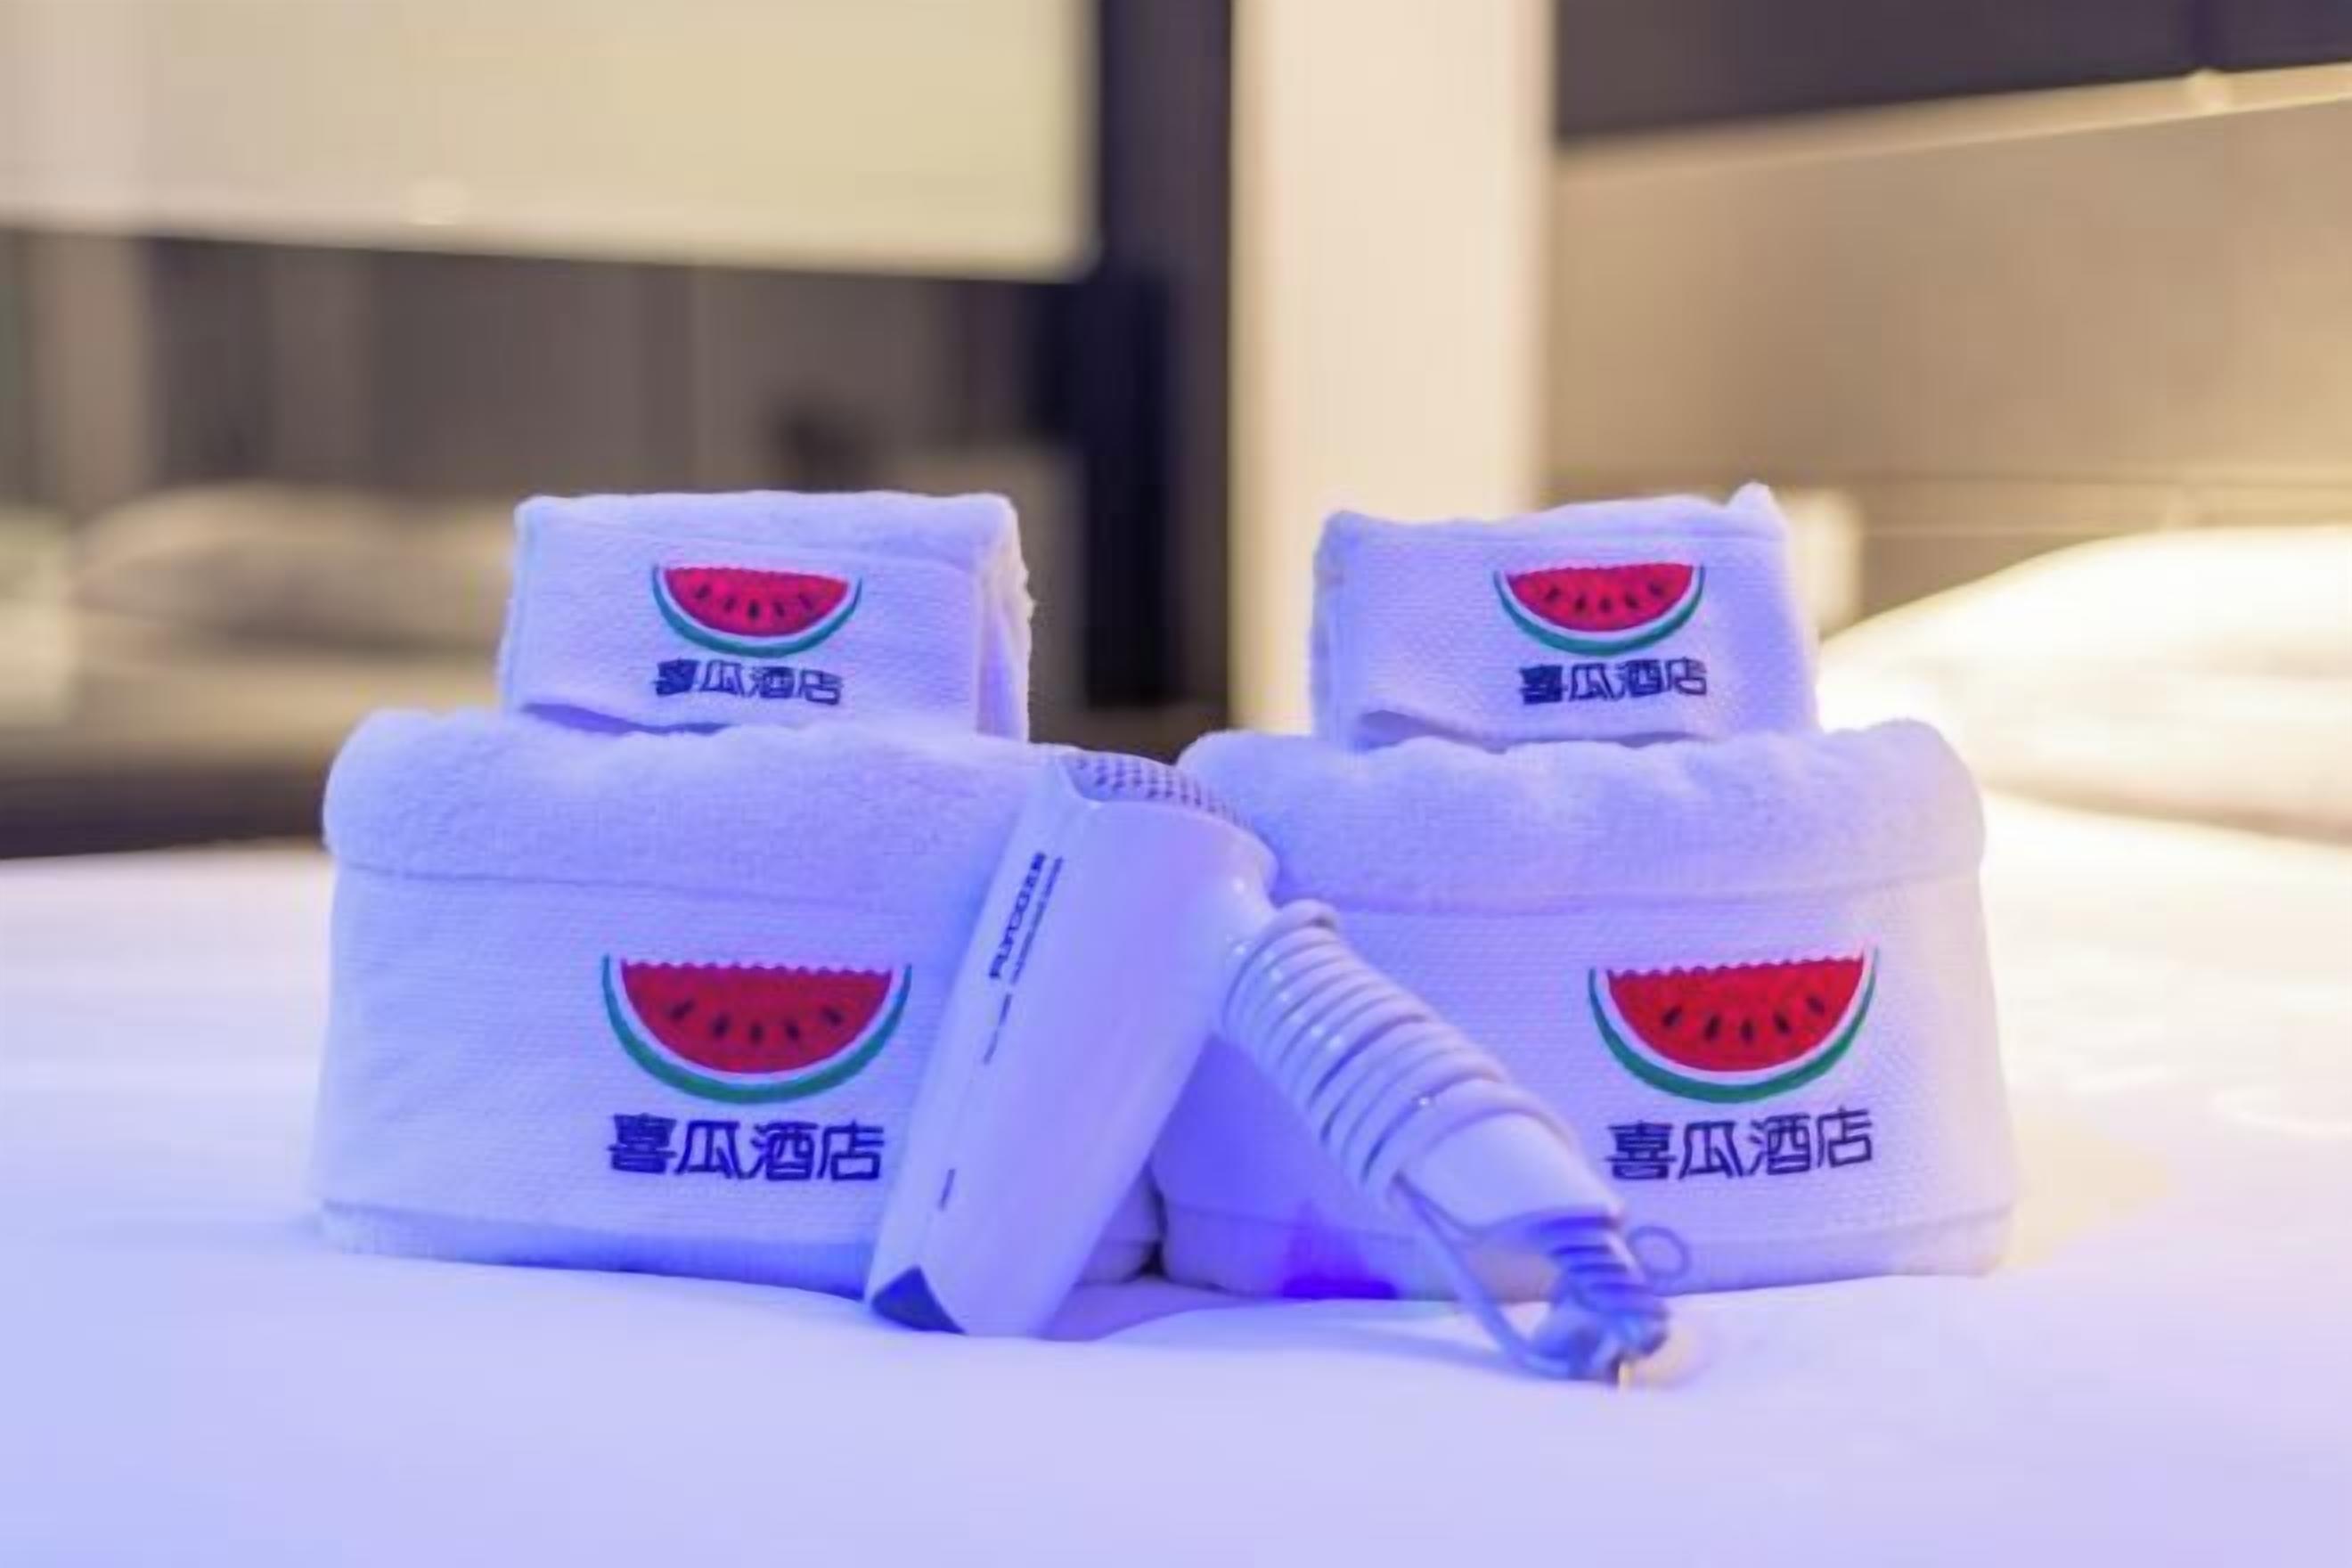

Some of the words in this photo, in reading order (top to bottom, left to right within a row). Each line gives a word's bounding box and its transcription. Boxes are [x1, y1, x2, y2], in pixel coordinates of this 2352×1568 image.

[608, 1113, 886, 1182] 喜瓜酒店
[1605, 1107, 1874, 1181] 喜瓜酒店
